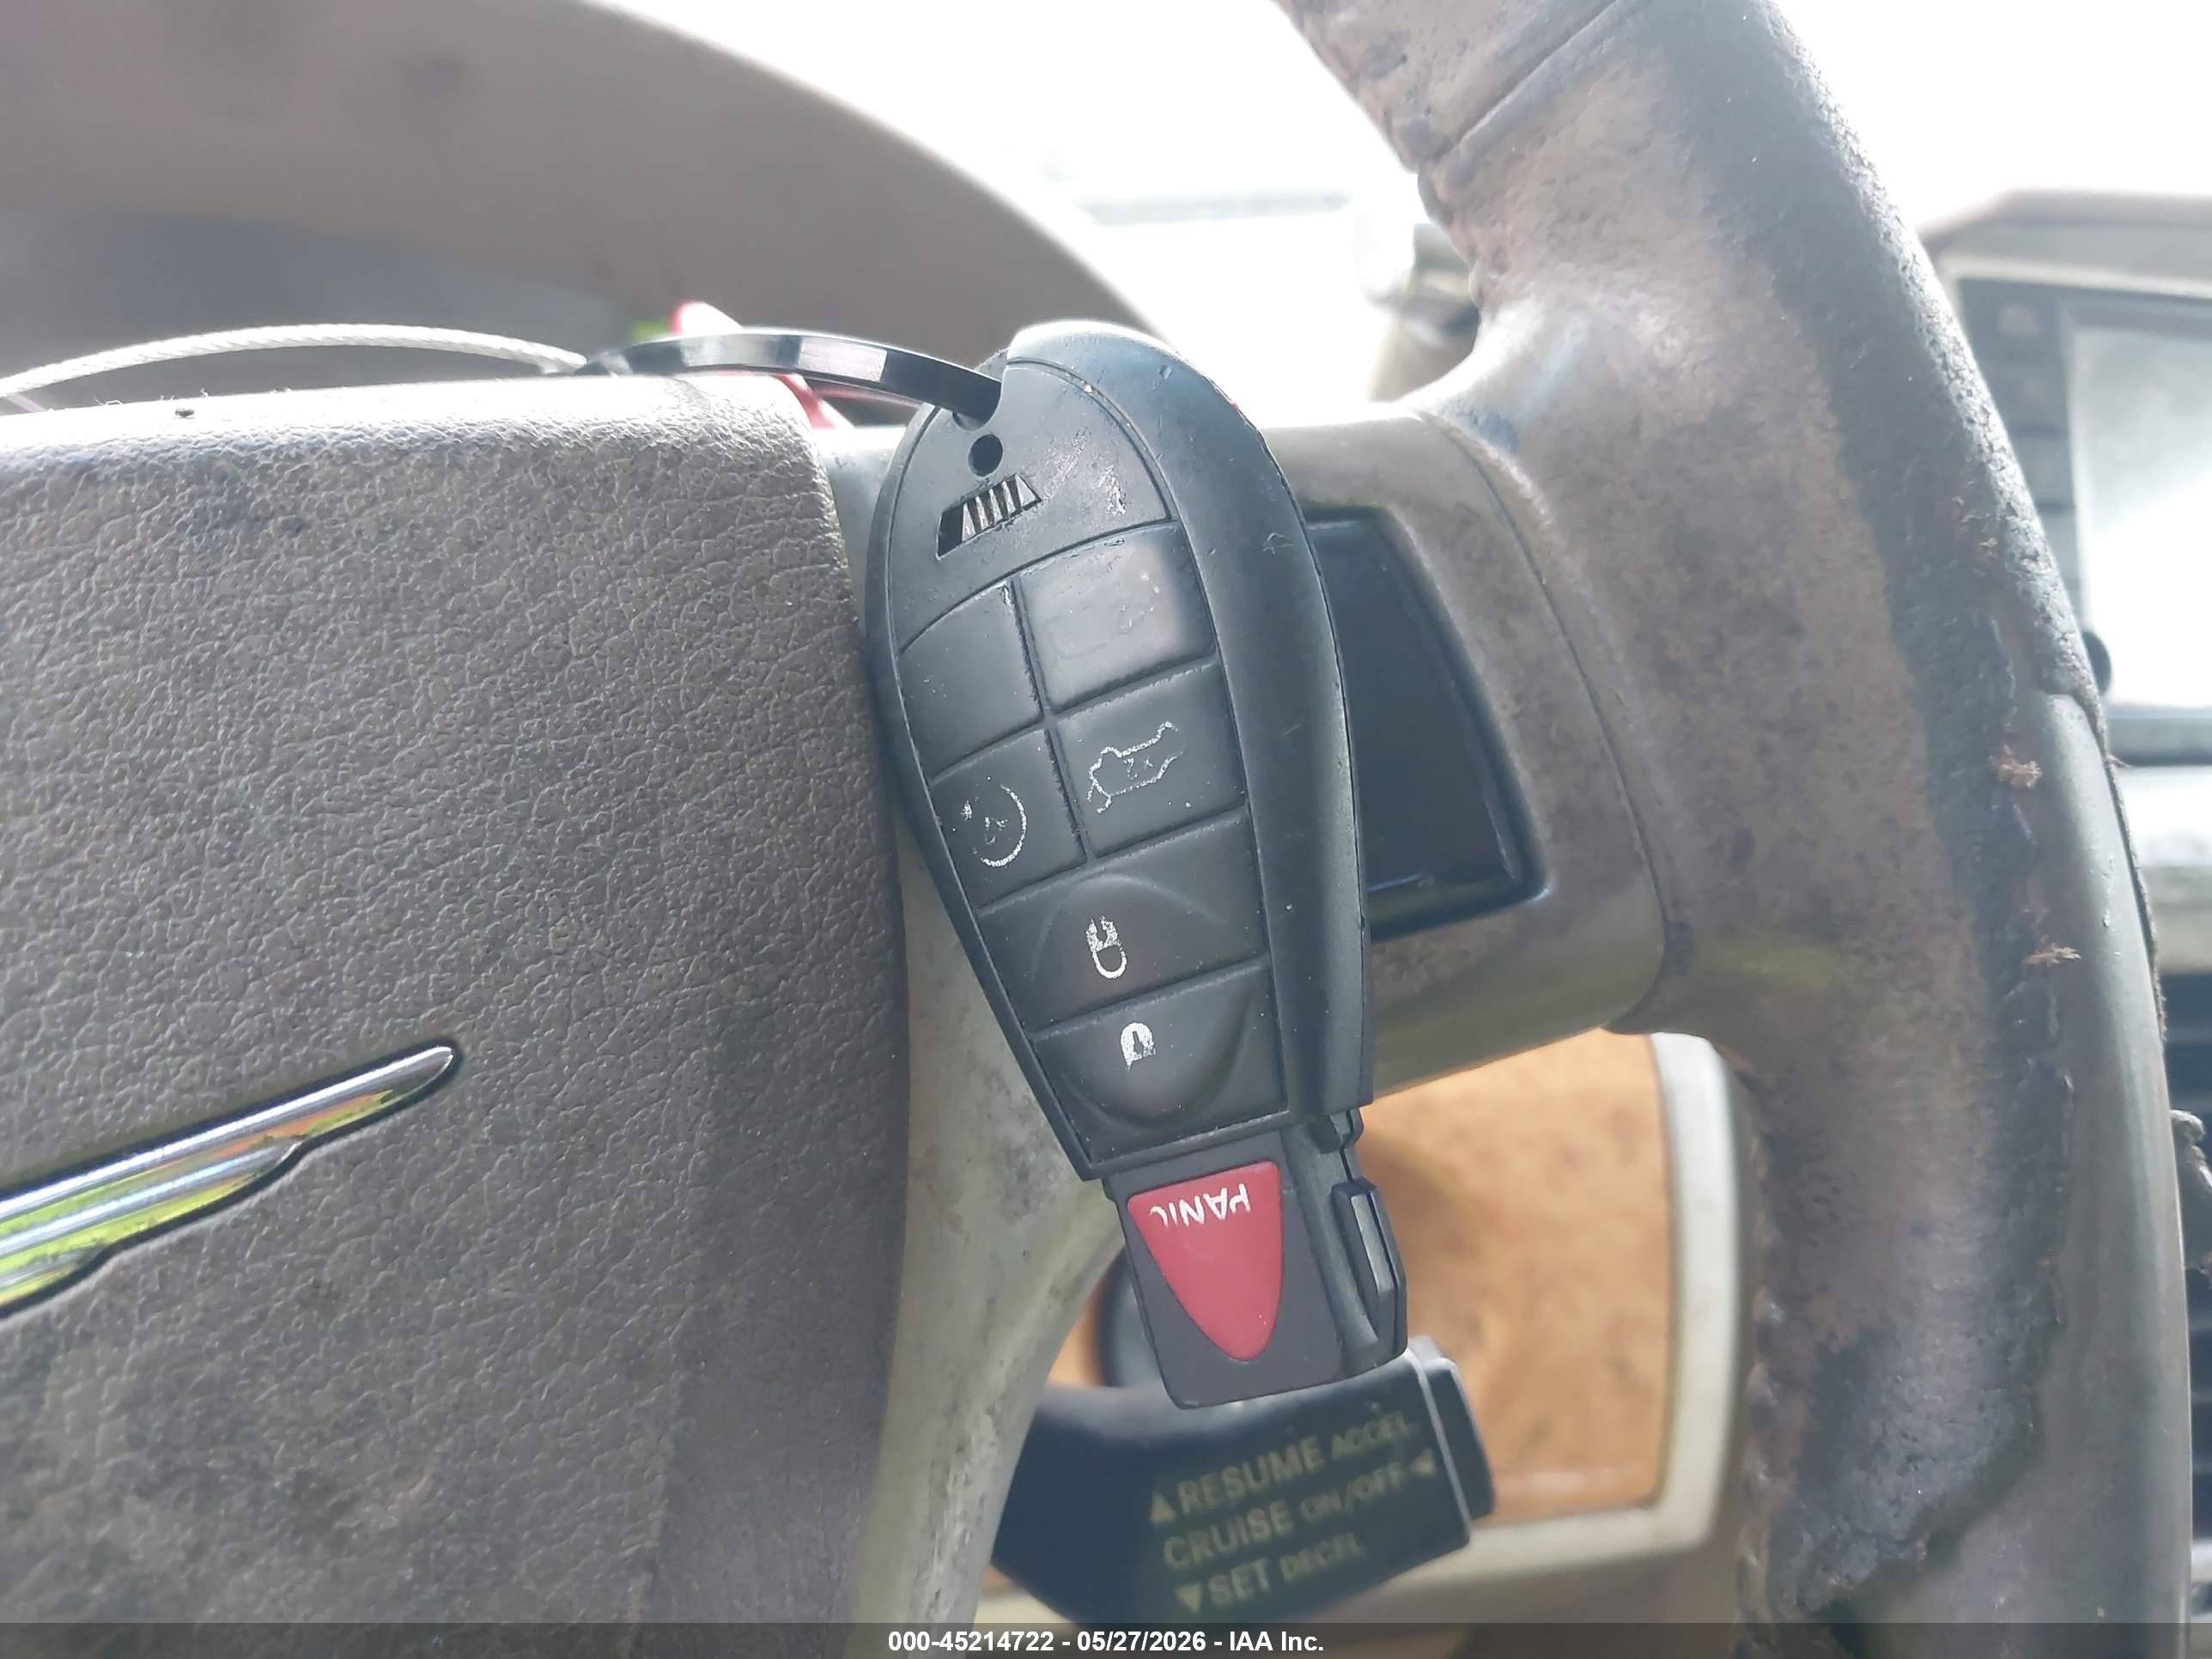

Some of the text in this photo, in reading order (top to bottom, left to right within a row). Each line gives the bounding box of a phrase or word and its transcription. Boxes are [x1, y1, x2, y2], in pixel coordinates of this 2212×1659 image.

[1163, 1461, 1404, 1571] CRUISE ON/OFF
[1177, 1435, 1325, 1516] RESUME
[1207, 1557, 1271, 1608] SET
